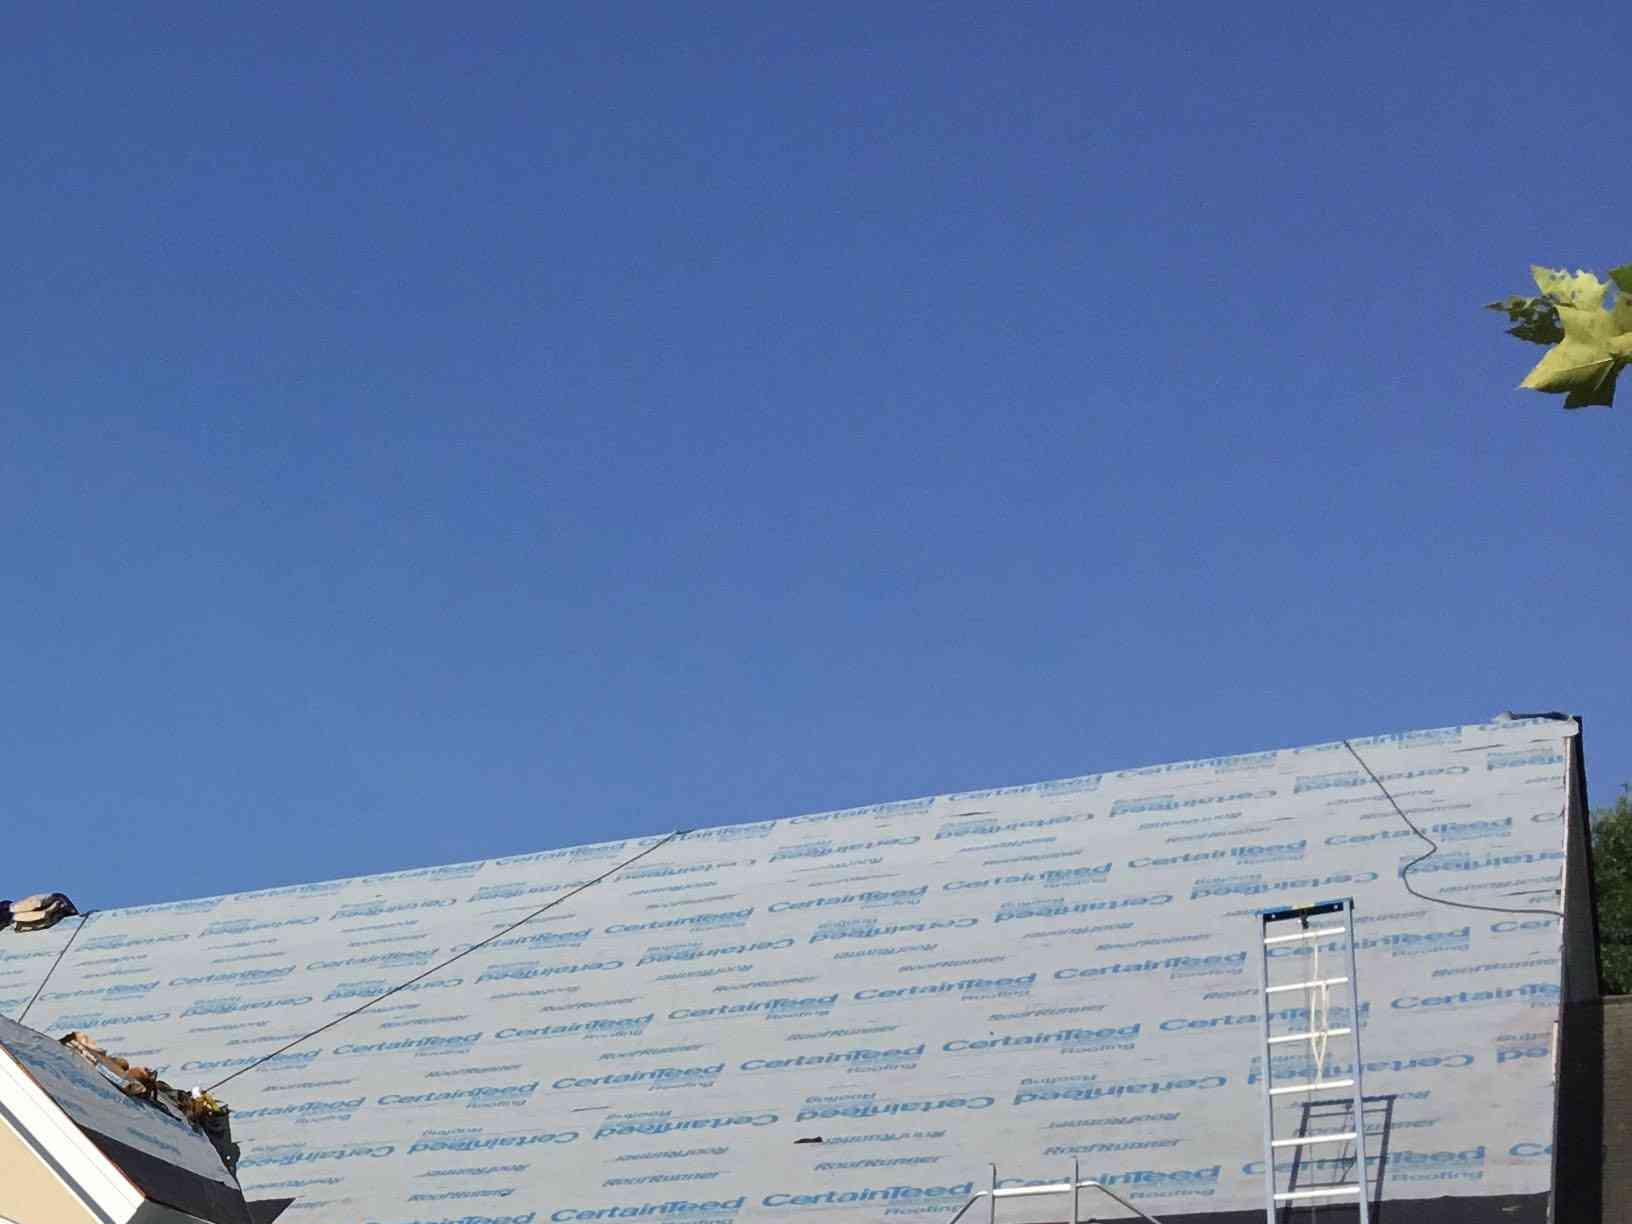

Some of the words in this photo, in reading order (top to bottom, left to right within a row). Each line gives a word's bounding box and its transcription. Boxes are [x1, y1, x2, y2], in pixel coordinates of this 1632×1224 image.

[768, 885, 928, 913] CertainTeed
[1054, 951, 1248, 980] CertainTeed
[854, 972, 1039, 1001] CertainTeed
[668, 993, 840, 1019] CertainTeed
[495, 1012, 655, 1039] CertainTeed
[942, 1023, 1141, 1053] CertainTeed
[332, 1032, 483, 1055] CertainTeed
[740, 1044, 925, 1072] CertainTeed
[552, 1063, 725, 1089] CertainTeed
[377, 1082, 540, 1105] CertainTeed
[1014, 1074, 1227, 1106] CertainTeed
[233, 1097, 367, 1119] ertainTeed
[795, 1096, 995, 1122] CertainTeed
[593, 1112, 779, 1141] CertainTeed
[407, 1130, 579, 1155] CertainTeed
[762, 1181, 975, 1208] CertainTeed
[551, 1196, 746, 1223] CertainTeed
